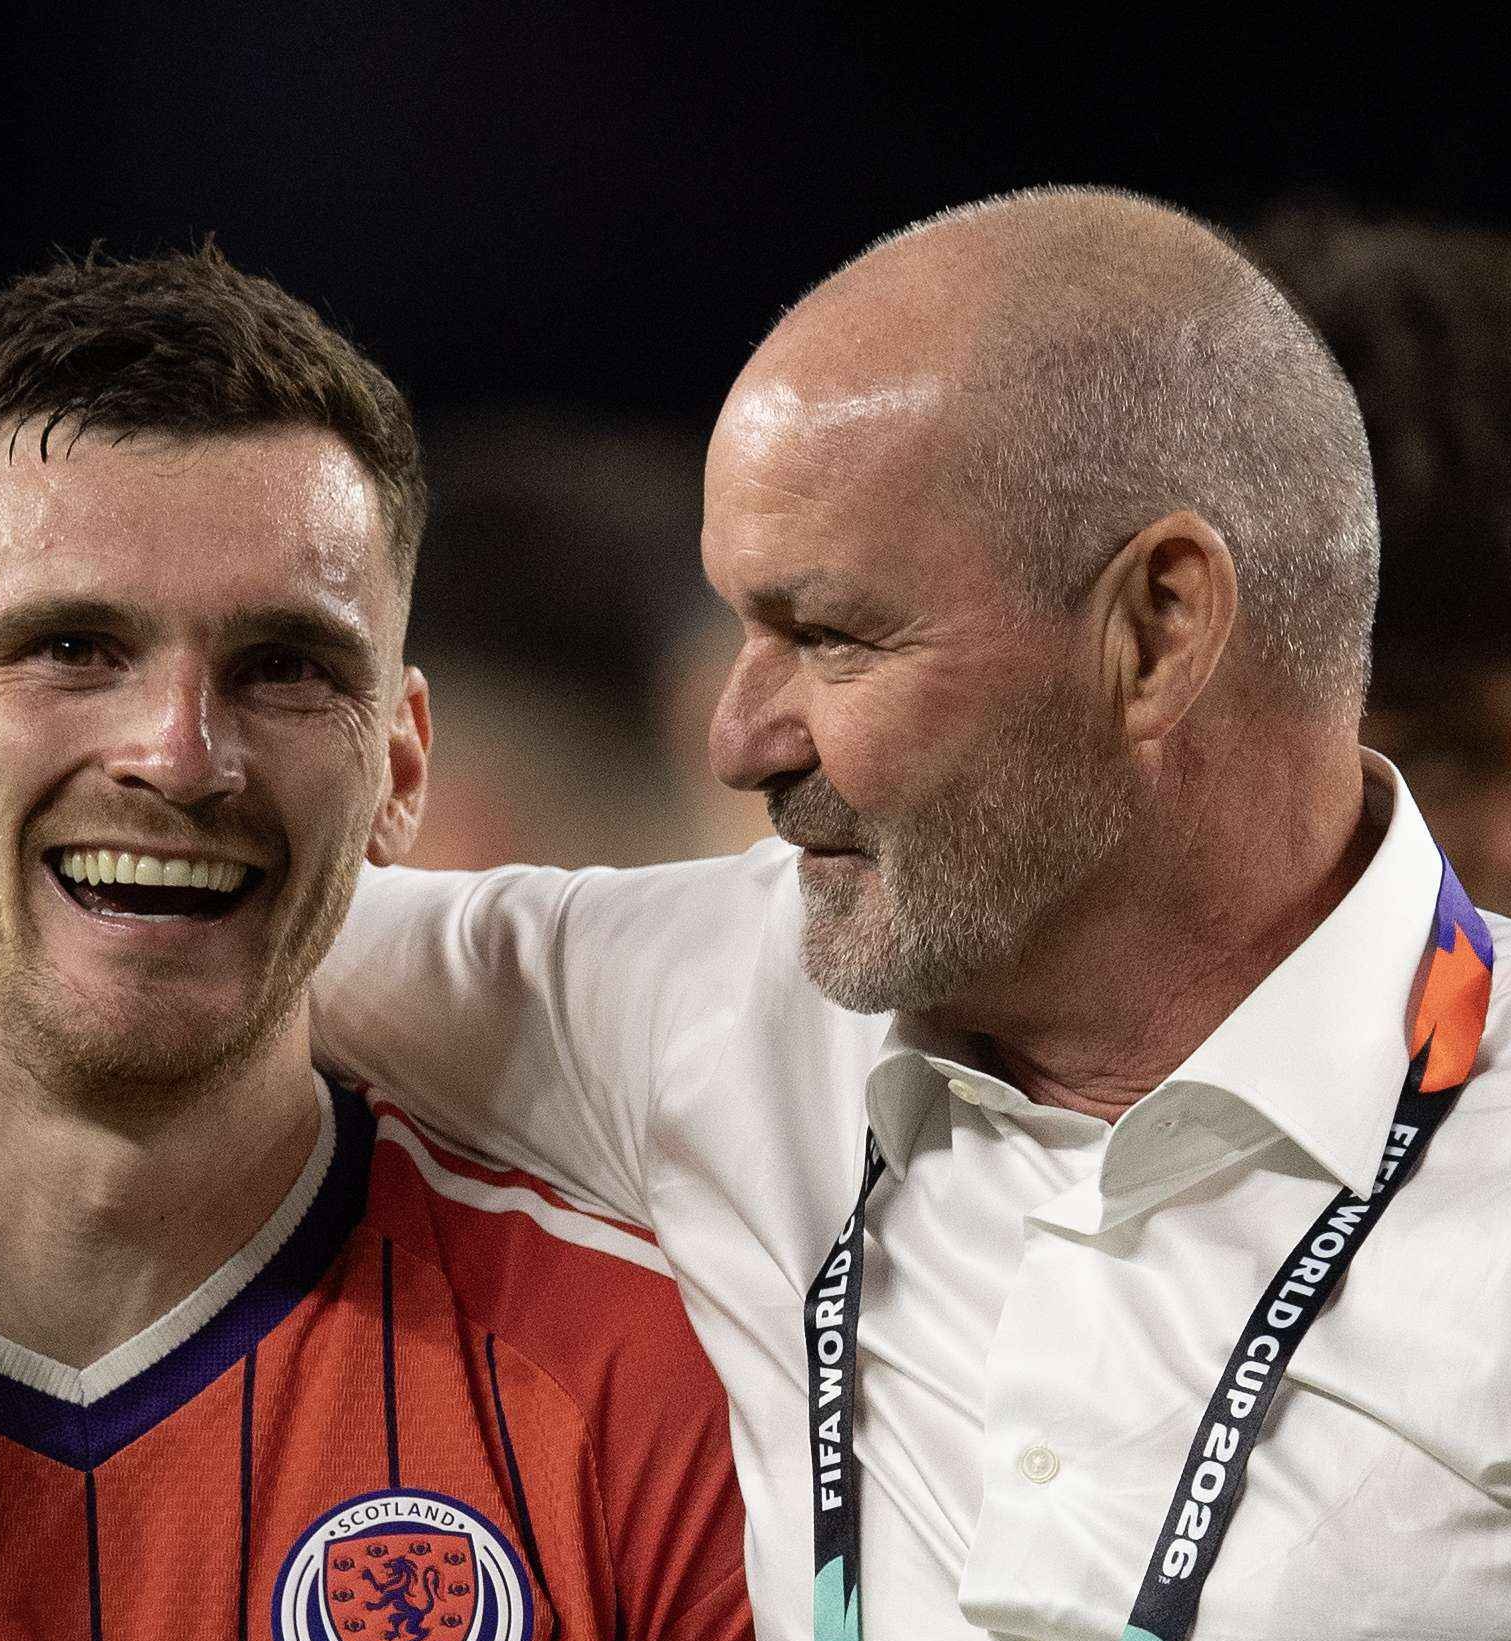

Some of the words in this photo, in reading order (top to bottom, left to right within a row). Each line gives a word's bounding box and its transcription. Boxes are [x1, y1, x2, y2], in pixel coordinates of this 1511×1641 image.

[1350, 1123, 1419, 1198] FIF
[1267, 1205, 1370, 1329] WORLD
[816, 1250, 851, 1408] WORLD
[1226, 1335, 1280, 1419] CUP
[818, 1410, 842, 1511] FIFA
[1162, 1423, 1239, 1580] 2026
[338, 1502, 455, 1533] SCOTLAND
